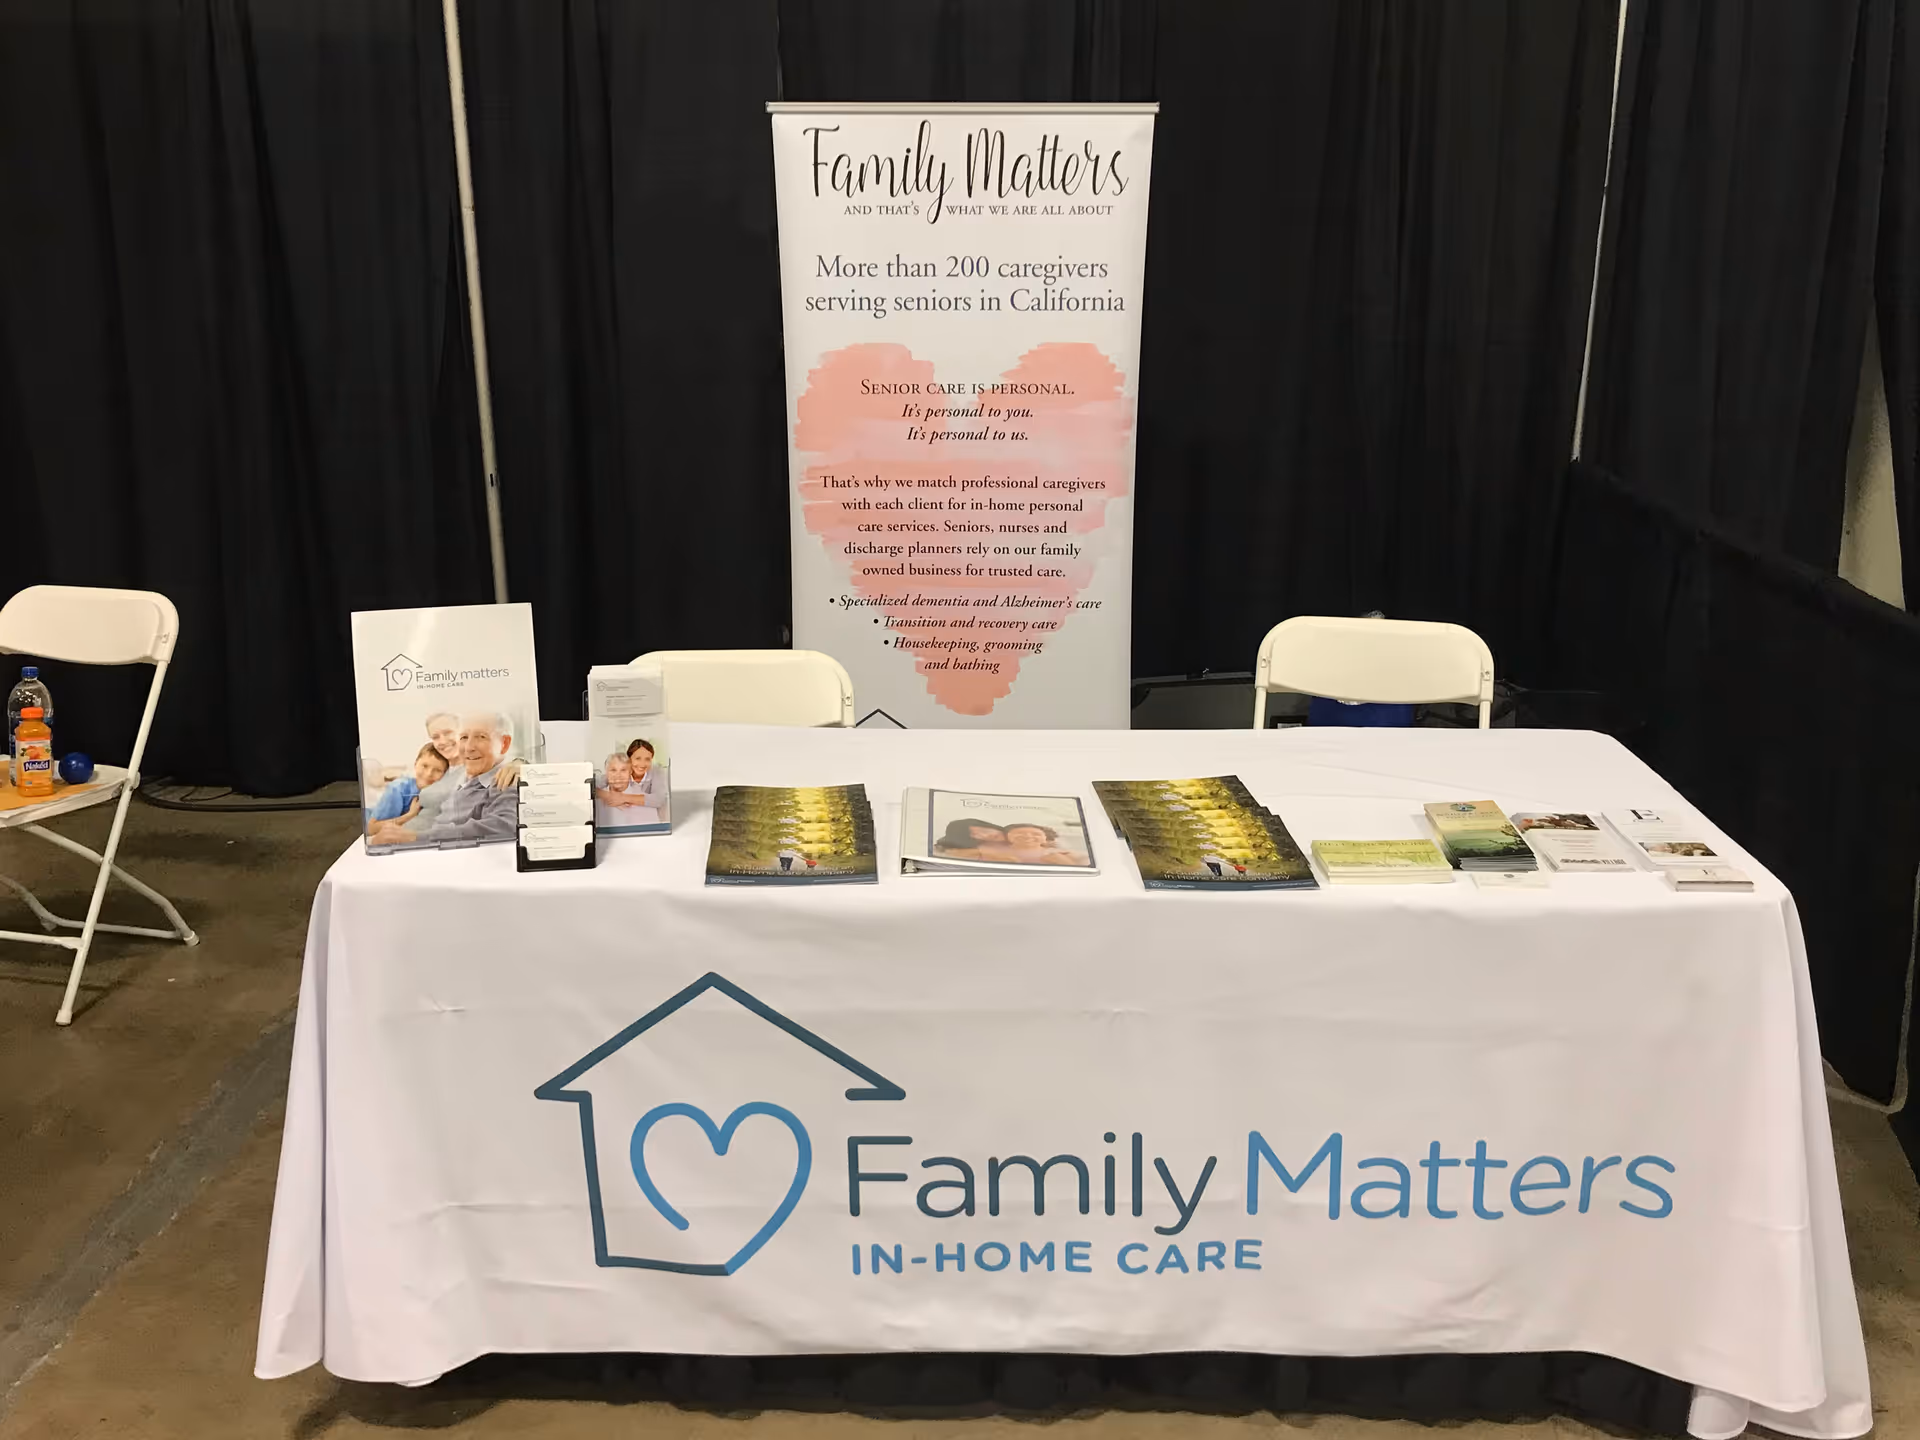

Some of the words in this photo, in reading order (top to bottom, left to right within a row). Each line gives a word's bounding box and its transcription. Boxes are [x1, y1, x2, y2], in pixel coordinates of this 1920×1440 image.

[802, 119, 954, 225] Family
[965, 126, 1130, 199] Matters
[844, 205, 872, 214] AND
[876, 201, 919, 215] THAT'S
[946, 205, 984, 215] WHAT
[989, 206, 1009, 215] WE
[1013, 206, 1037, 215] ARE
[1041, 206, 1064, 215] ALL
[1069, 205, 1113, 215] ABOUT
[817, 255, 878, 277] More
[886, 254, 936, 277] than
[946, 256, 989, 277] 200
[998, 256, 1107, 285] caregivers
[806, 289, 886, 319] serving
[894, 289, 971, 311] seniors
[980, 289, 1000, 310] in
[1010, 288, 1124, 311] California
[861, 380, 921, 394] SENIOR
[927, 384, 966, 394] CARE
[972, 384, 984, 394] IS
[992, 384, 1074, 394] PERSONAL.
[902, 404, 921, 417] It's
[924, 404, 984, 421] personal
[988, 407, 1001, 418] to
[1004, 409, 1033, 422] you.
[908, 427, 926, 440] It's
[929, 426, 989, 444] personal
[993, 431, 1005, 441] to
[1011, 431, 1027, 441] us.
[820, 476, 859, 488] That's
[864, 475, 891, 491] why
[895, 479, 912, 488] we
[918, 476, 956, 487] match
[962, 475, 1038, 491] professional
[1043, 478, 1105, 493] caregivers
[842, 498, 871, 509] with
[875, 498, 903, 509] each
[908, 498, 943, 510] client
[948, 498, 966, 510] for
[971, 498, 1024, 510] in-home
[1029, 499, 1082, 514] personal
[858, 523, 883, 533] care
[887, 520, 938, 531] services.
[944, 520, 994, 532] Seniors,
[999, 524, 1039, 534] nurses
[1044, 521, 1067, 533] and
[844, 542, 903, 557] discharge
[908, 542, 962, 557] planners
[967, 542, 990, 557] rely
[994, 546, 1010, 555] on
[1015, 546, 1036, 555] our
[1041, 543, 1080, 558] family
[863, 564, 904, 575] owned
[909, 563, 961, 575] business
[966, 564, 984, 575] for
[989, 564, 1032, 576] trusted
[1037, 568, 1065, 578] care.
[839, 594, 909, 610] Specialized
[912, 594, 969, 606] dementia
[973, 595, 998, 607] and
[1000, 595, 1072, 608] Alzheimer's
[1076, 600, 1101, 609] care
[884, 616, 946, 627] Transition
[950, 616, 975, 628] and
[979, 621, 1028, 632] recovery
[1032, 621, 1057, 630] care
[894, 637, 979, 653] Housekeeping,
[983, 639, 1043, 654] grooming
[925, 658, 950, 669] and
[953, 658, 1000, 674] bathing
[416, 670, 459, 683] Family
[461, 668, 509, 679] matters
[846, 1132, 1217, 1235] Family
[1244, 1129, 1677, 1223] Matters
[850, 1239, 1094, 1278] IN-HOME
[1114, 1237, 1266, 1275] CARE
